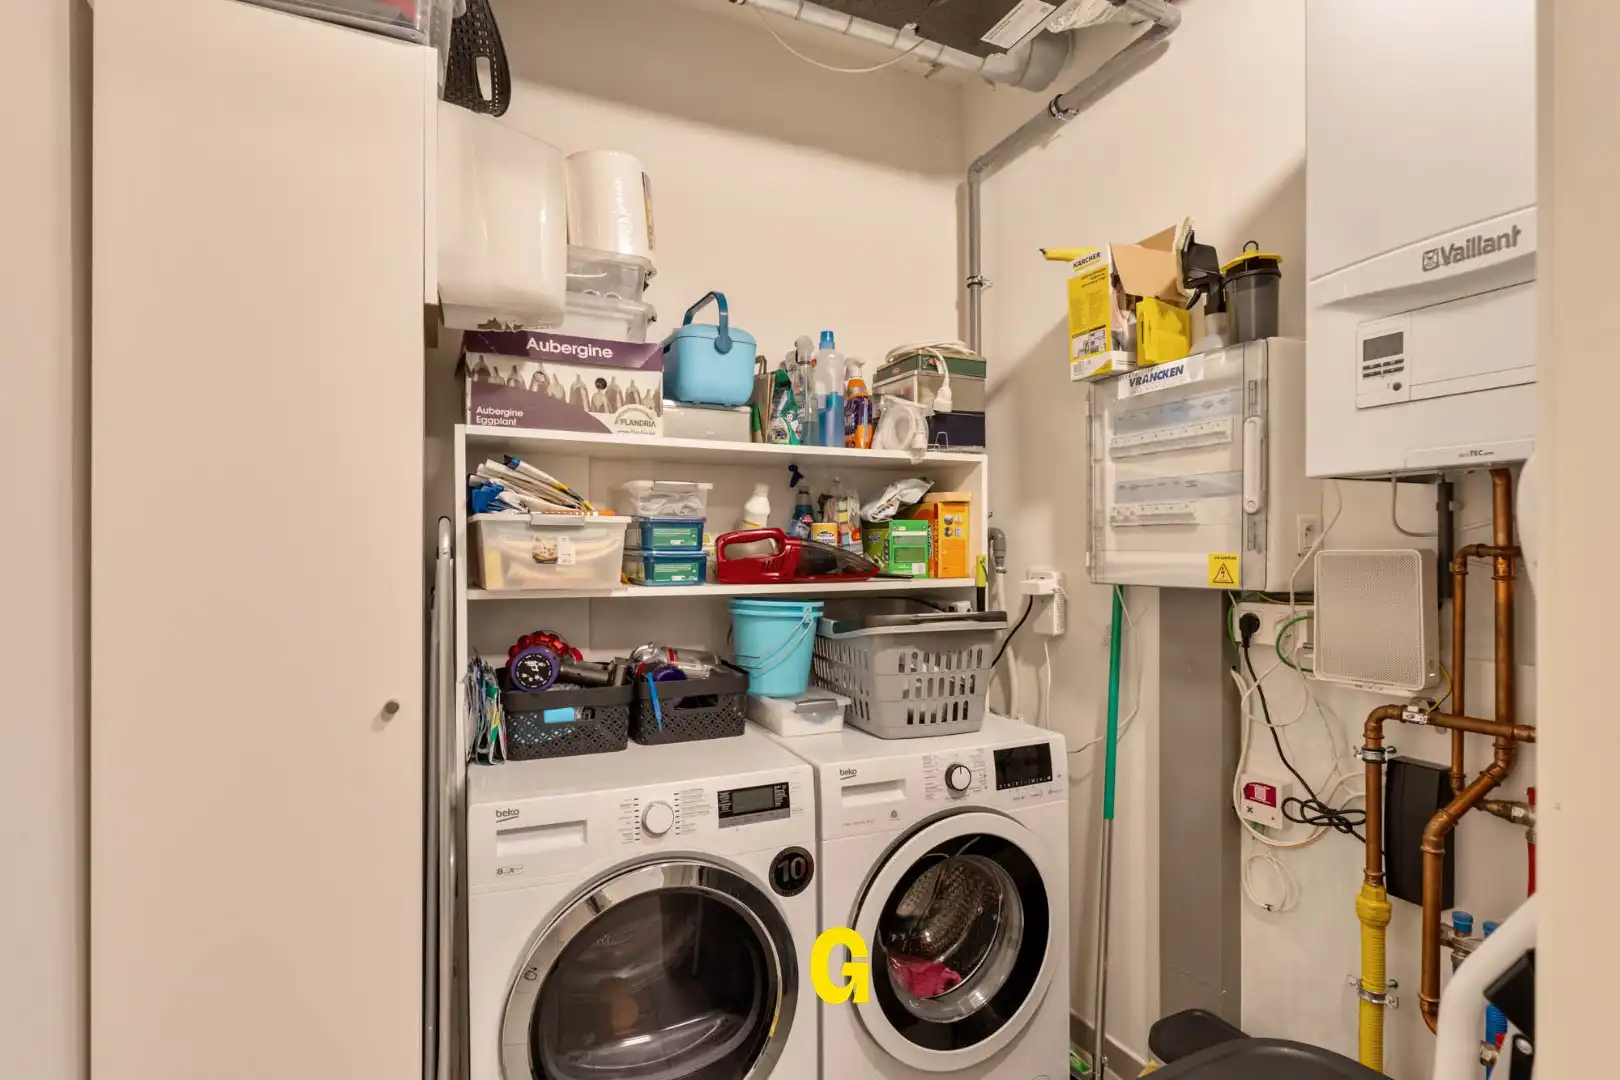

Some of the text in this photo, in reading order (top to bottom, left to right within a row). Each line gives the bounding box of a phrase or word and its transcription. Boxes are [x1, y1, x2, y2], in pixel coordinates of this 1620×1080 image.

[1440, 225, 1521, 266] Vaillant
[525, 337, 613, 359] Aubergine
[1129, 364, 1184, 388] VRANCKEN
[476, 405, 524, 418] Aubergine
[476, 416, 517, 427] Eggplant
[620, 418, 656, 428] FLANDRIA
[839, 768, 857, 776] beko
[495, 808, 519, 818] beko
[777, 856, 806, 882] 10
